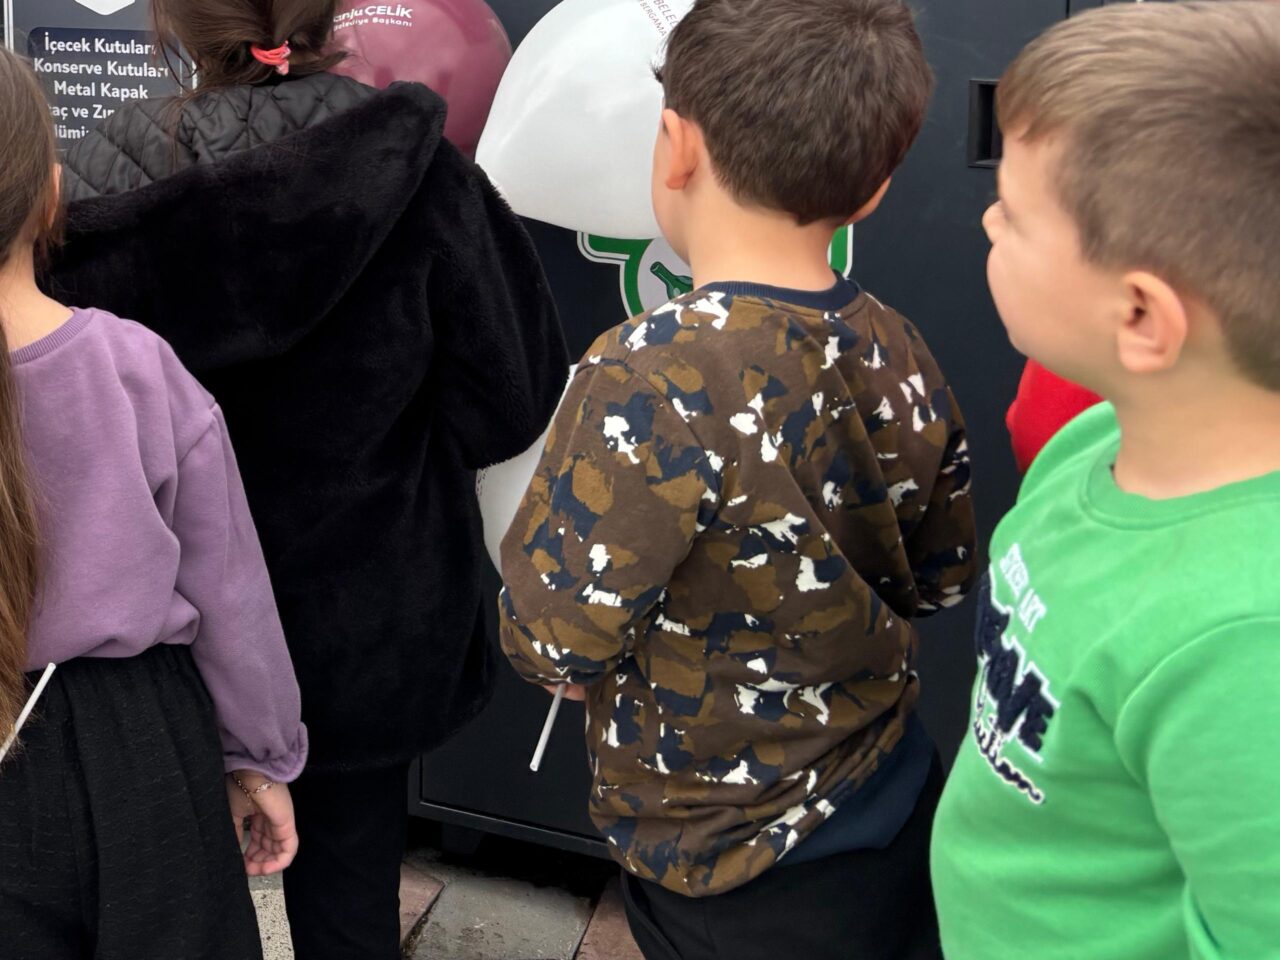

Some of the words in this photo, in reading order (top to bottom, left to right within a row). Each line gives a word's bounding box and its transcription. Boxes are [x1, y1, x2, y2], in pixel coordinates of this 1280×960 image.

[333, 8, 364, 23] anju
[364, 4, 413, 18] ÇELİK
[372, 17, 413, 28] Başkanı
[44, 31, 91, 55] İçecek
[34, 58, 102, 74] Konserve
[54, 80, 96, 97] Metal
[100, 83, 149, 101] Kapak
[71, 106, 89, 118] ve
[55, 124, 90, 140] lümi
